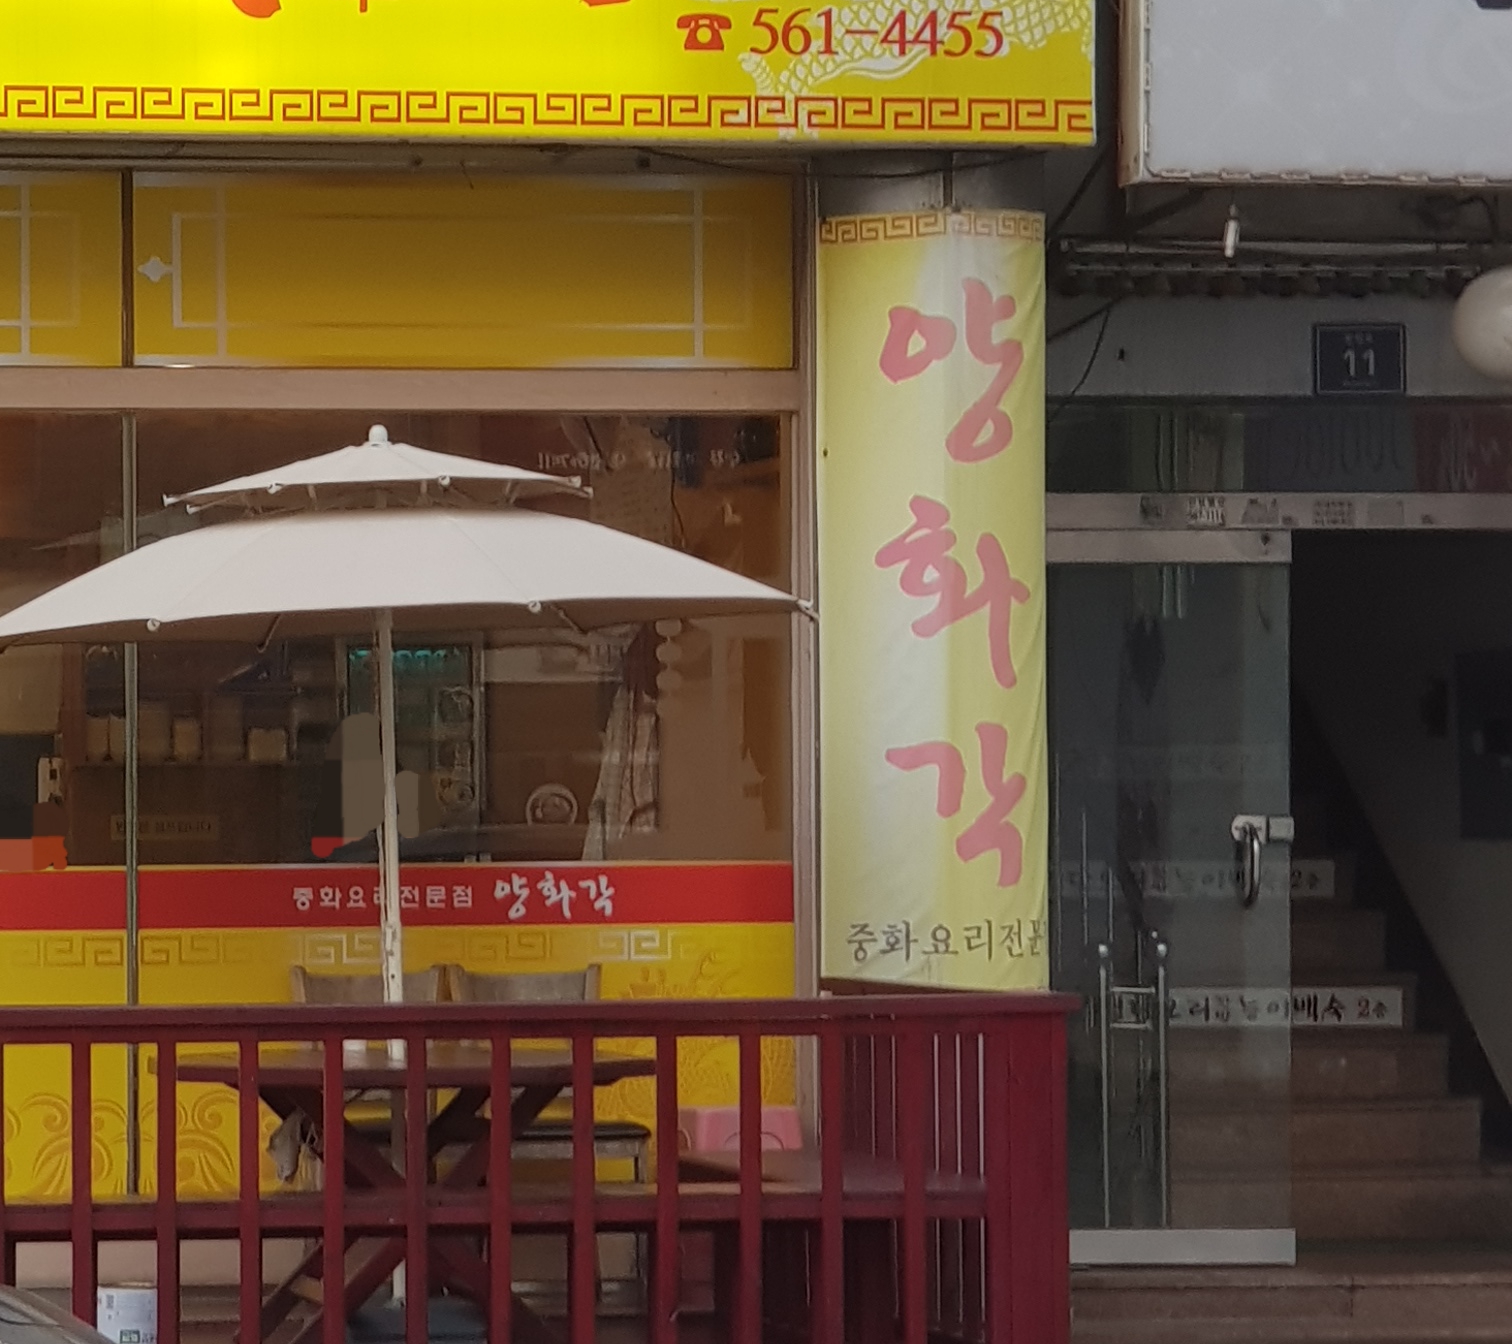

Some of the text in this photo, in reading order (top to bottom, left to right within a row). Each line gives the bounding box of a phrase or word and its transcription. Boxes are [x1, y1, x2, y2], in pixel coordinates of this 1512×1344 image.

[749, 6, 1005, 59] 561-4455
[874, 276, 1033, 890] 양화각
[494, 870, 616, 920] 양화각
